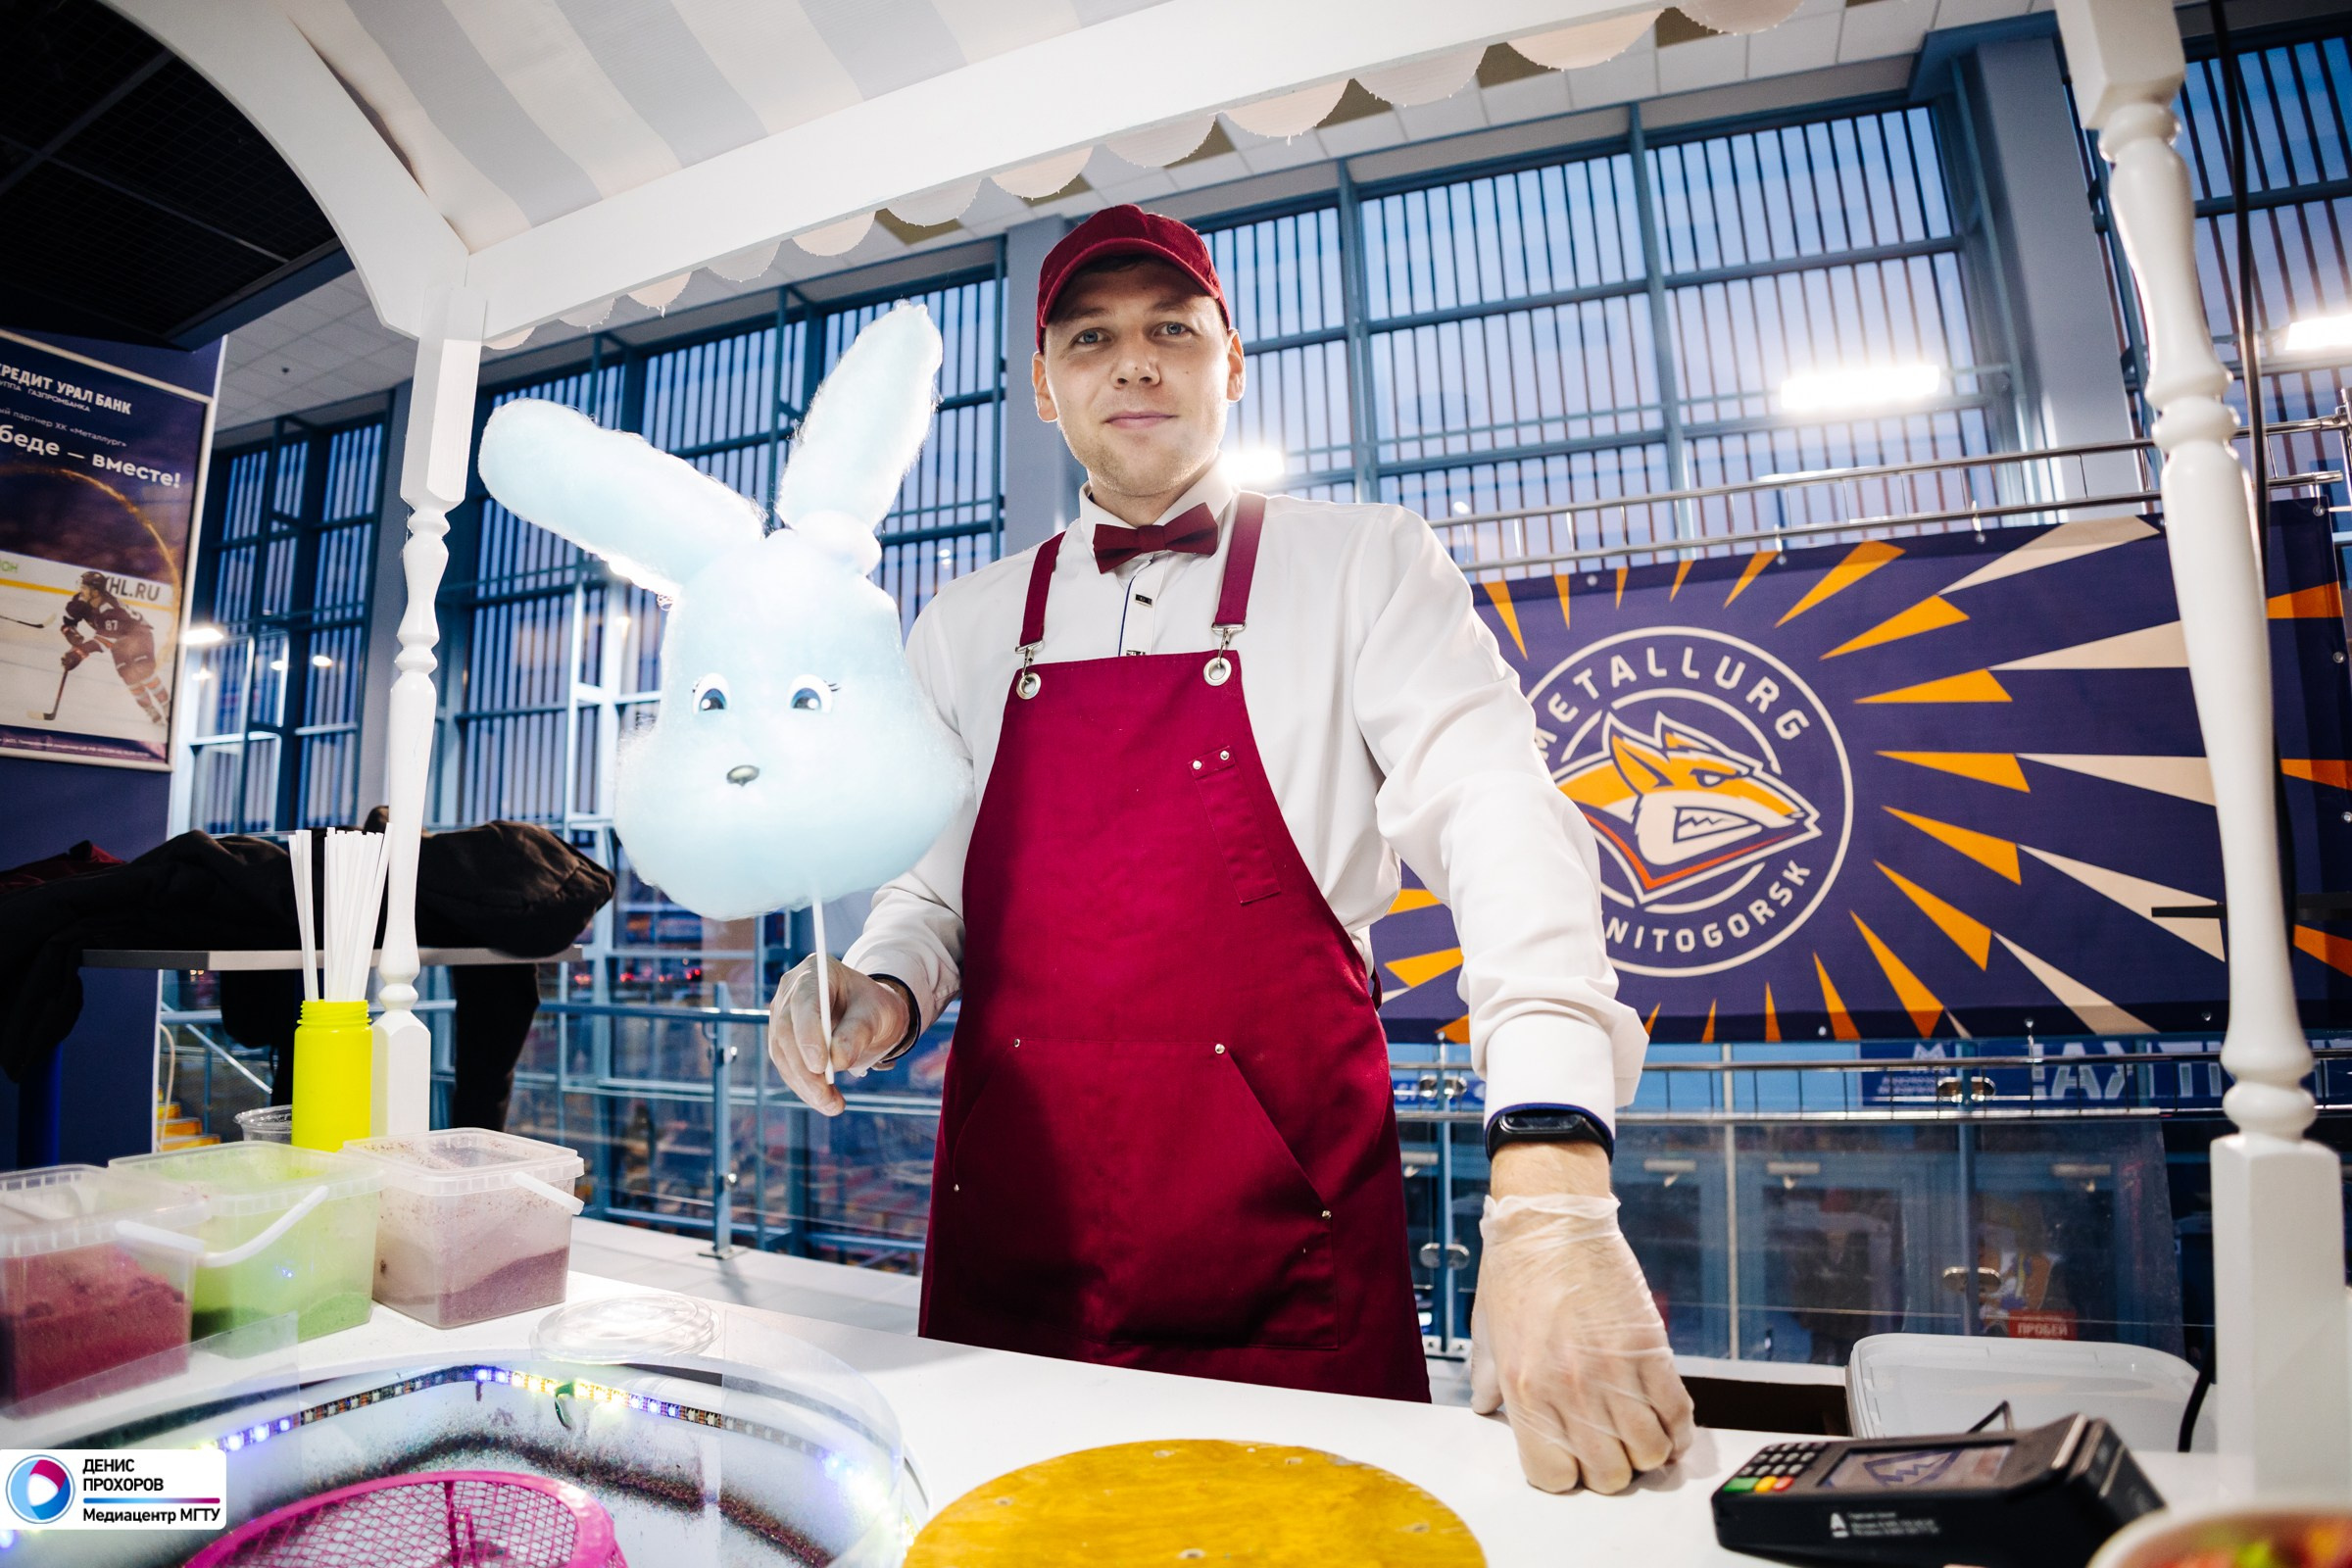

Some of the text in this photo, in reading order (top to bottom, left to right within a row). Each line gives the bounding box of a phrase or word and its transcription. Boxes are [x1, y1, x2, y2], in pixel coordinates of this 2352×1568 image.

[0, 363, 132, 416] РЕДИТ УРАЛ БАНК
[27, 389, 91, 413] ГАЗПРОМБАНКА
[14, 412, 54, 427] партнер
[55, 421, 68, 432] ХК
[70, 427, 127, 448] «Металлург»
[92, 454, 181, 488] вместе!
[106, 576, 161, 602] HL.RU
[1535, 647, 1810, 760] METALLURG
[1601, 858, 1811, 954] NITOGORSK
